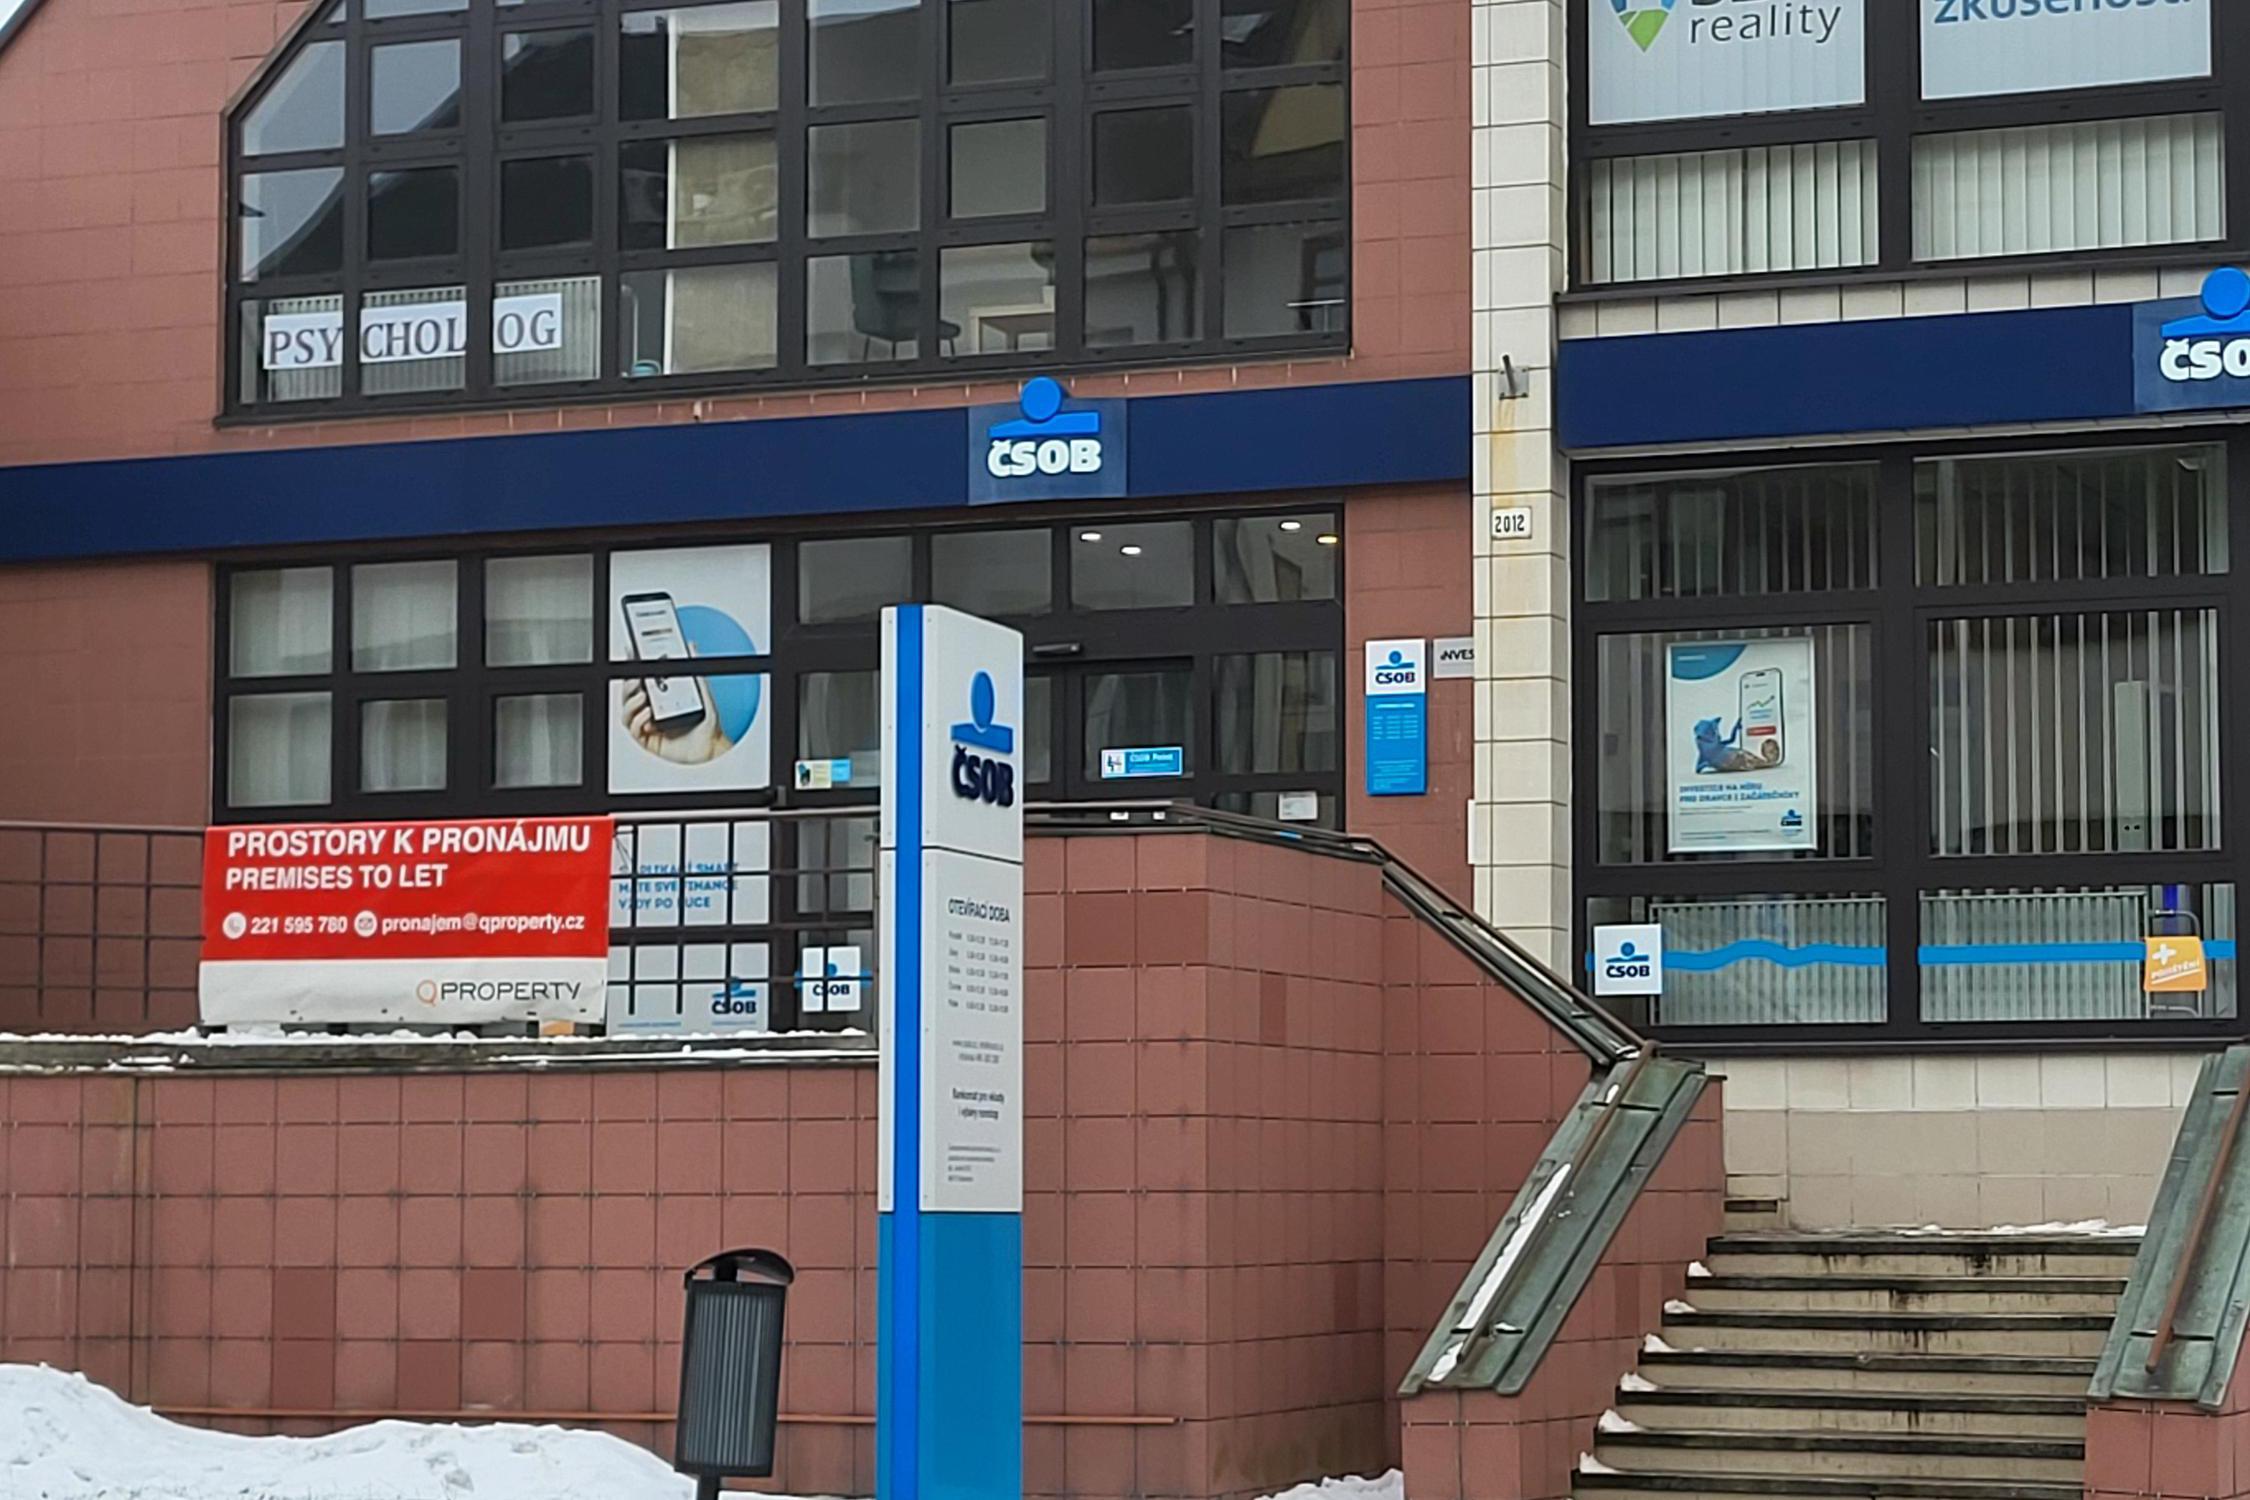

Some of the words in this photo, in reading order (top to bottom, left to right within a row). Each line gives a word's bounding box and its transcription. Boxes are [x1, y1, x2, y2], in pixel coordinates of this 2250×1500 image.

[1690, 2, 1842, 44] reality
[2160, 337, 2250, 381] ČSO
[987, 439, 1102, 478] ČSOB
[1495, 513, 1525, 533] 2012
[952, 743, 1014, 808] ČSOB
[228, 829, 386, 857] PROSTORY
[393, 828, 415, 855] K
[421, 819, 591, 854] PRONÁJMU
[225, 865, 353, 891] PREMISES
[358, 864, 393, 889] TO
[398, 863, 448, 888] LET
[250, 916, 279, 934] 221
[284, 915, 314, 934] 595
[381, 913, 585, 935] pronajem@qproperty.cz
[416, 980, 581, 1007] QPROPERTY
